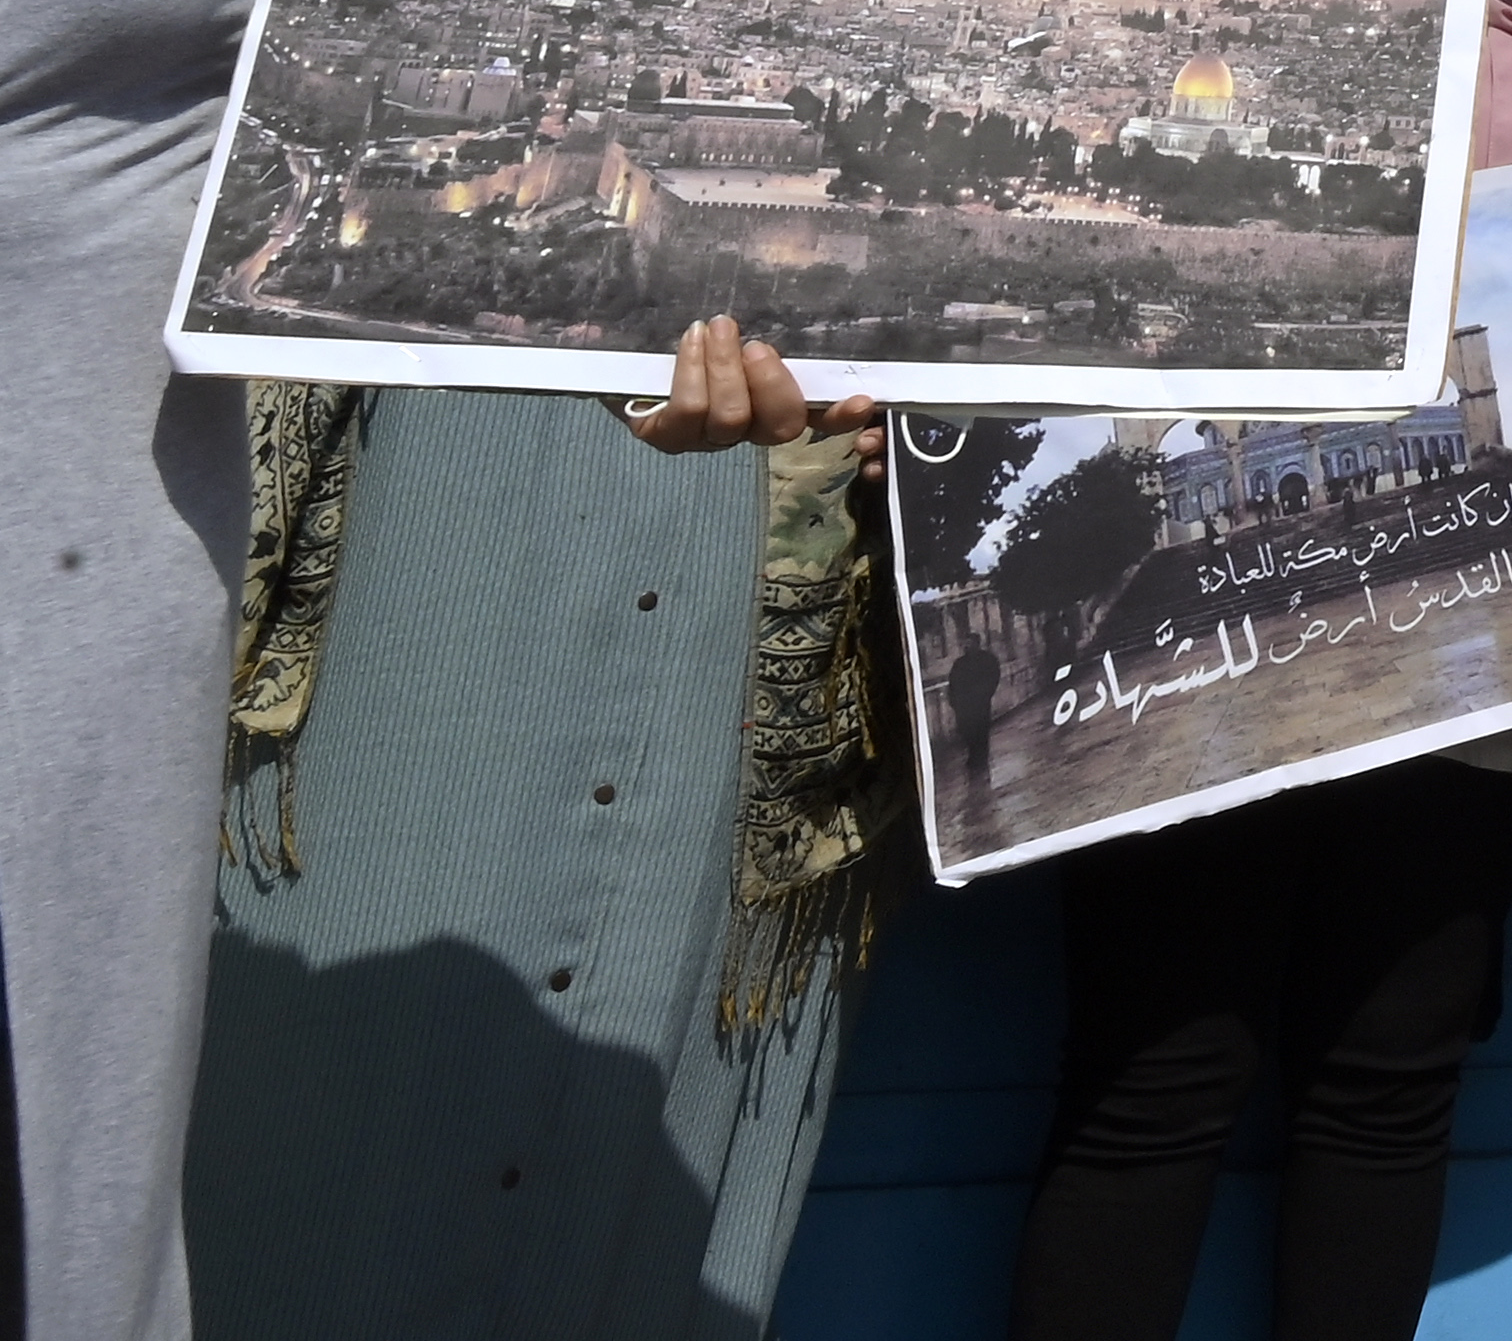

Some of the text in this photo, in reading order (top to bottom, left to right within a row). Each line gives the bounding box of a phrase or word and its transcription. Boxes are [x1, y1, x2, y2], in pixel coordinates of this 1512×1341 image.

[1352, 496, 1418, 566] أرض
[1422, 481, 1490, 538] كانت
[1198, 542, 1275, 596] للعبادة
[1279, 538, 1349, 578] مكة
